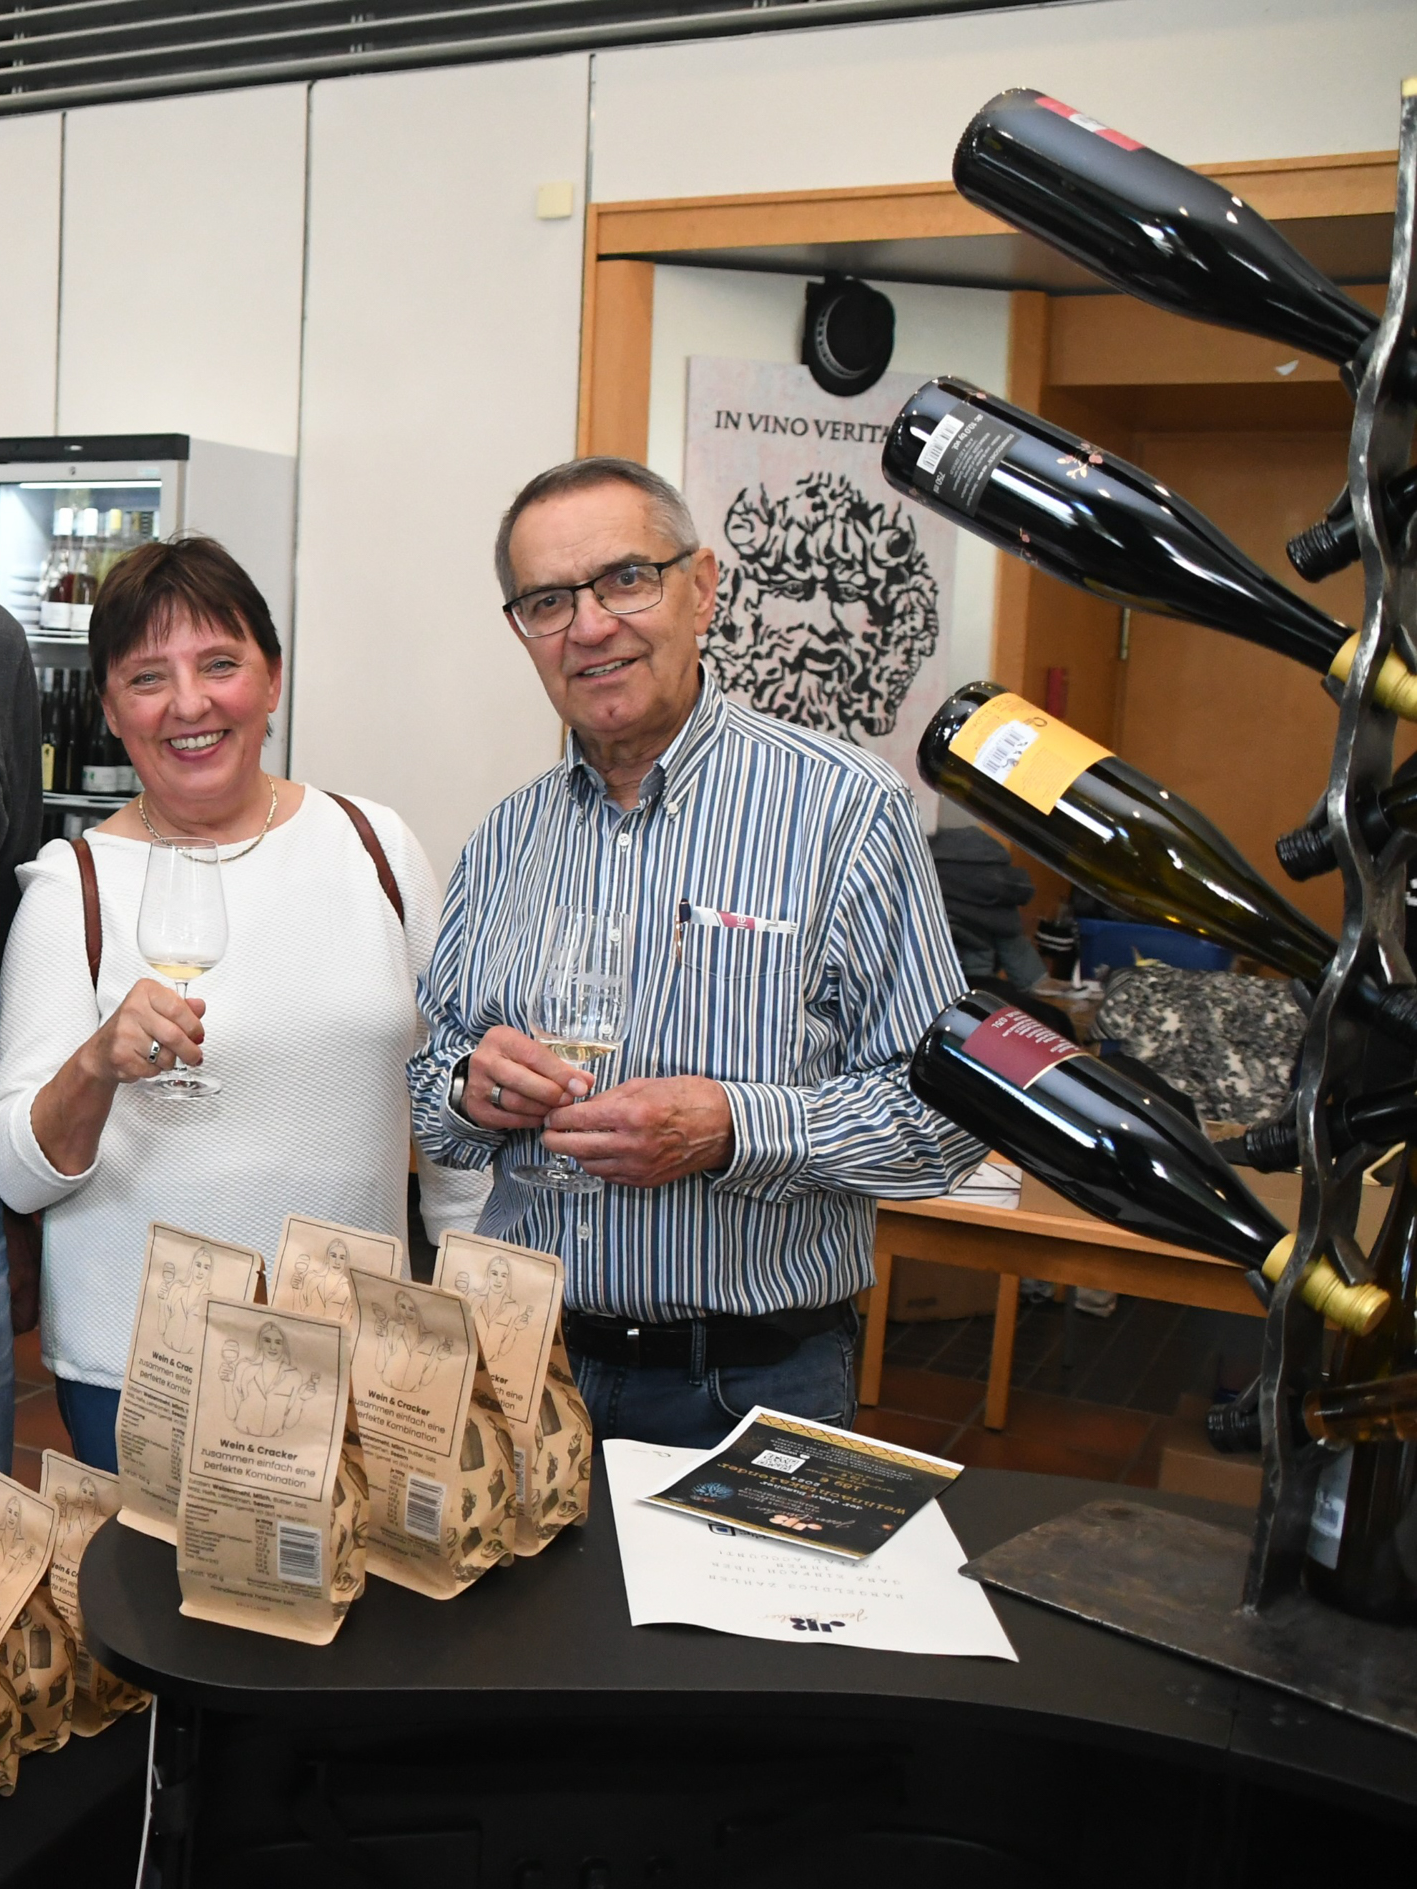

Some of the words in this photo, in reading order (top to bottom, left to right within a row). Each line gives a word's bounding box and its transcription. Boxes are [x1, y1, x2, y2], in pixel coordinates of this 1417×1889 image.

[715, 410, 742, 430] IN
[747, 413, 809, 436] VINO
[152, 1351, 169, 1364] Wein
[139, 1358, 174, 1377] zusammen
[140, 1370, 166, 1386] perfekte
[369, 1390, 388, 1403] Wein
[397, 1401, 430, 1416] Cracker
[506, 1390, 523, 1401] eine
[357, 1411, 384, 1425] erfekte
[387, 1422, 437, 1443] Kombination
[396, 1413, 425, 1427] einfach
[428, 1423, 445, 1434] eine
[220, 1439, 245, 1451] Wein
[257, 1446, 298, 1461] Cracker
[201, 1448, 254, 1464] zusammen
[256, 1458, 292, 1473] einfach
[295, 1467, 316, 1477] eine
[204, 1460, 243, 1475] perfekte
[246, 1469, 306, 1488] Kombination
[791, 1476, 821, 1487] 2024
[717, 1462, 906, 1515] Weihnachtskalender
[811, 1493, 839, 1505] Jean
[842, 1503, 863, 1511] der
[708, 1575, 776, 1588] ZAHLEN
[788, 1584, 904, 1599] BARGELDLOS
